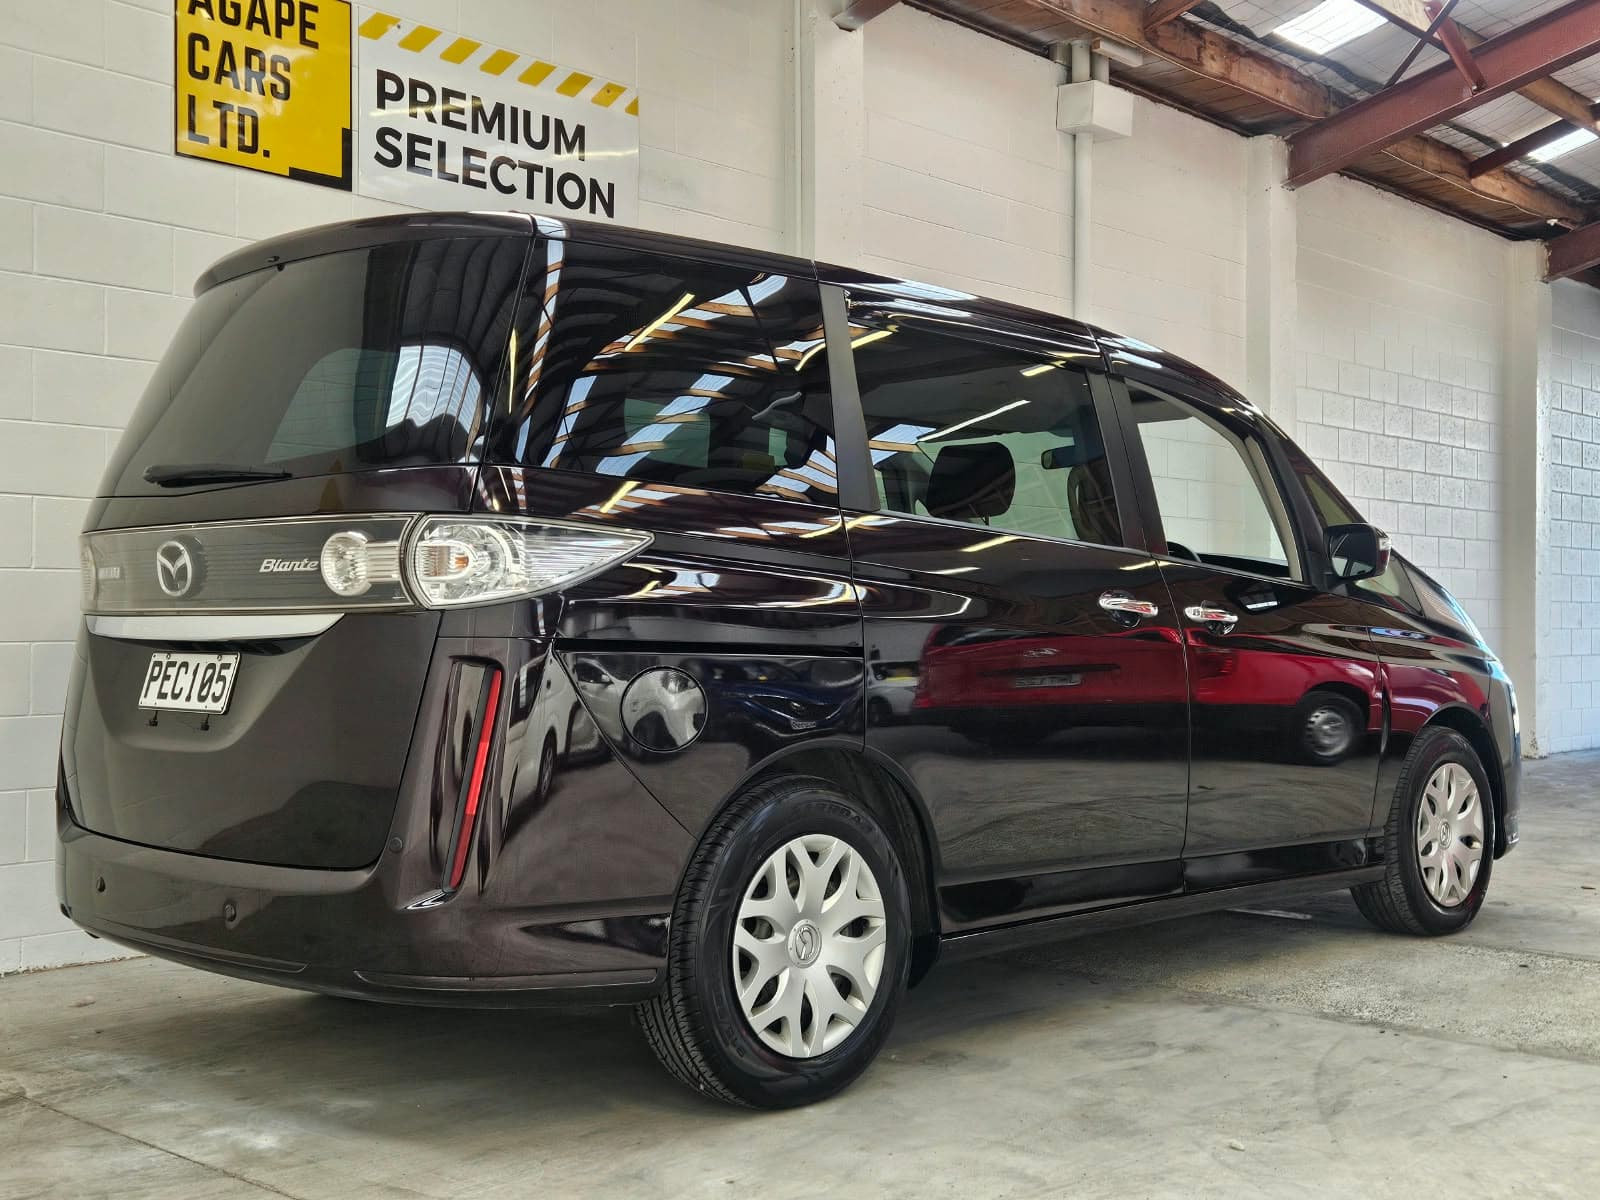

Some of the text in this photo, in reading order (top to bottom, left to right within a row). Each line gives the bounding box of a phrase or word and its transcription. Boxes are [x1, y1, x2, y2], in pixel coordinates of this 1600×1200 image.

[187, 32, 291, 101] CARS
[187, 94, 271, 158] LTD.
[376, 68, 586, 161] PREMIUM
[373, 126, 615, 218] SELECTION
[143, 660, 233, 703] PEC105
